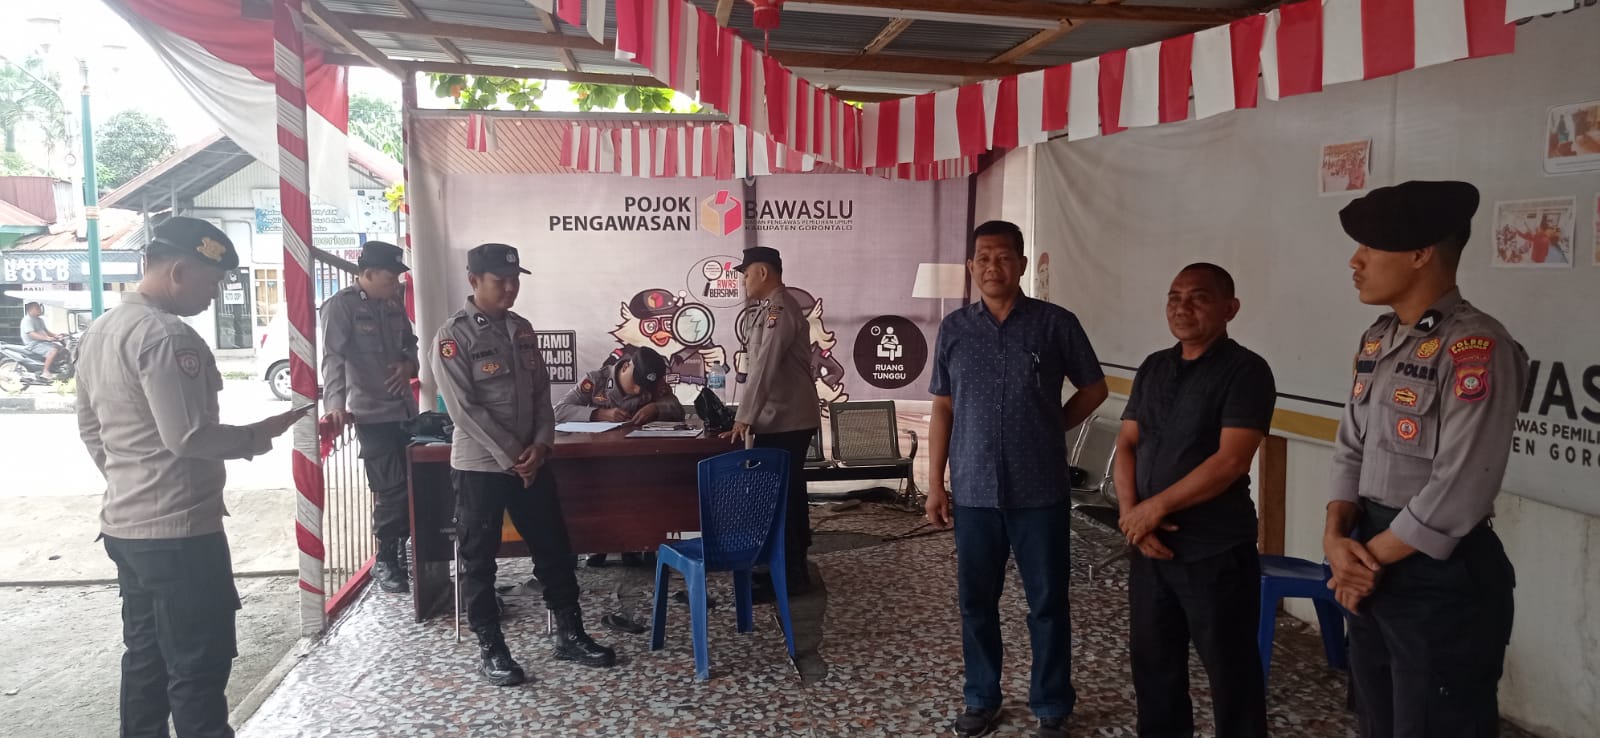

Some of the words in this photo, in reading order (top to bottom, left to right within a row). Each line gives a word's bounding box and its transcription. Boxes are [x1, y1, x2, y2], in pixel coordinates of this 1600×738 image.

[624, 196, 691, 212] POJOK
[745, 200, 853, 219] BAWASLU
[549, 215, 690, 231] PENGAWASAN
[5, 269, 69, 281] BOLD
[710, 289, 739, 297] BERSAMA
[537, 335, 570, 349] TAMU
[546, 366, 573, 380] POR
[872, 372, 906, 380] TUNGGU
[1395, 362, 1437, 381] POLRI
[1514, 419, 1548, 436] WAS
[1549, 443, 1600, 467] GOR
